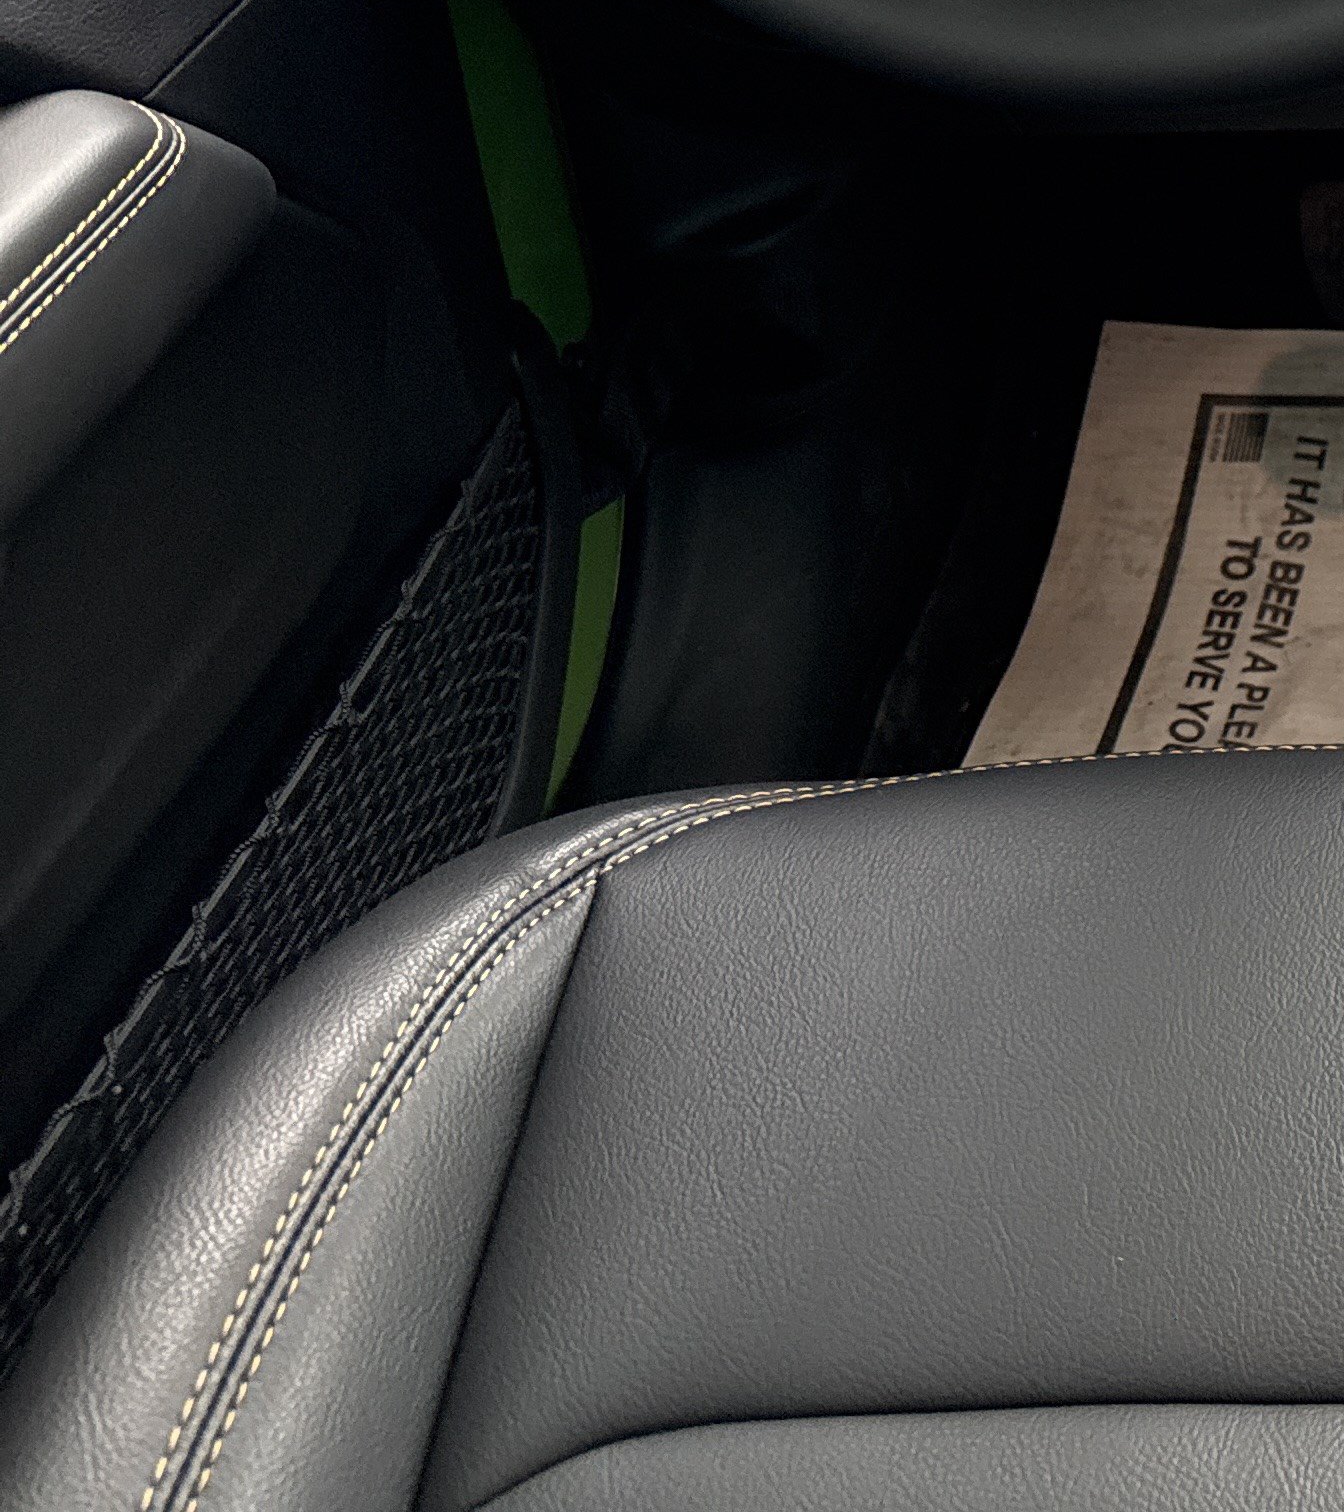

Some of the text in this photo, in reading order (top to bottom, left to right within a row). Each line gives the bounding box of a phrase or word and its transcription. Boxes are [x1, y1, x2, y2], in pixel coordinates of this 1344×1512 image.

[1185, 536, 1262, 692] TO SERVE
[1242, 436, 1329, 673] IT HAS BEEN A
